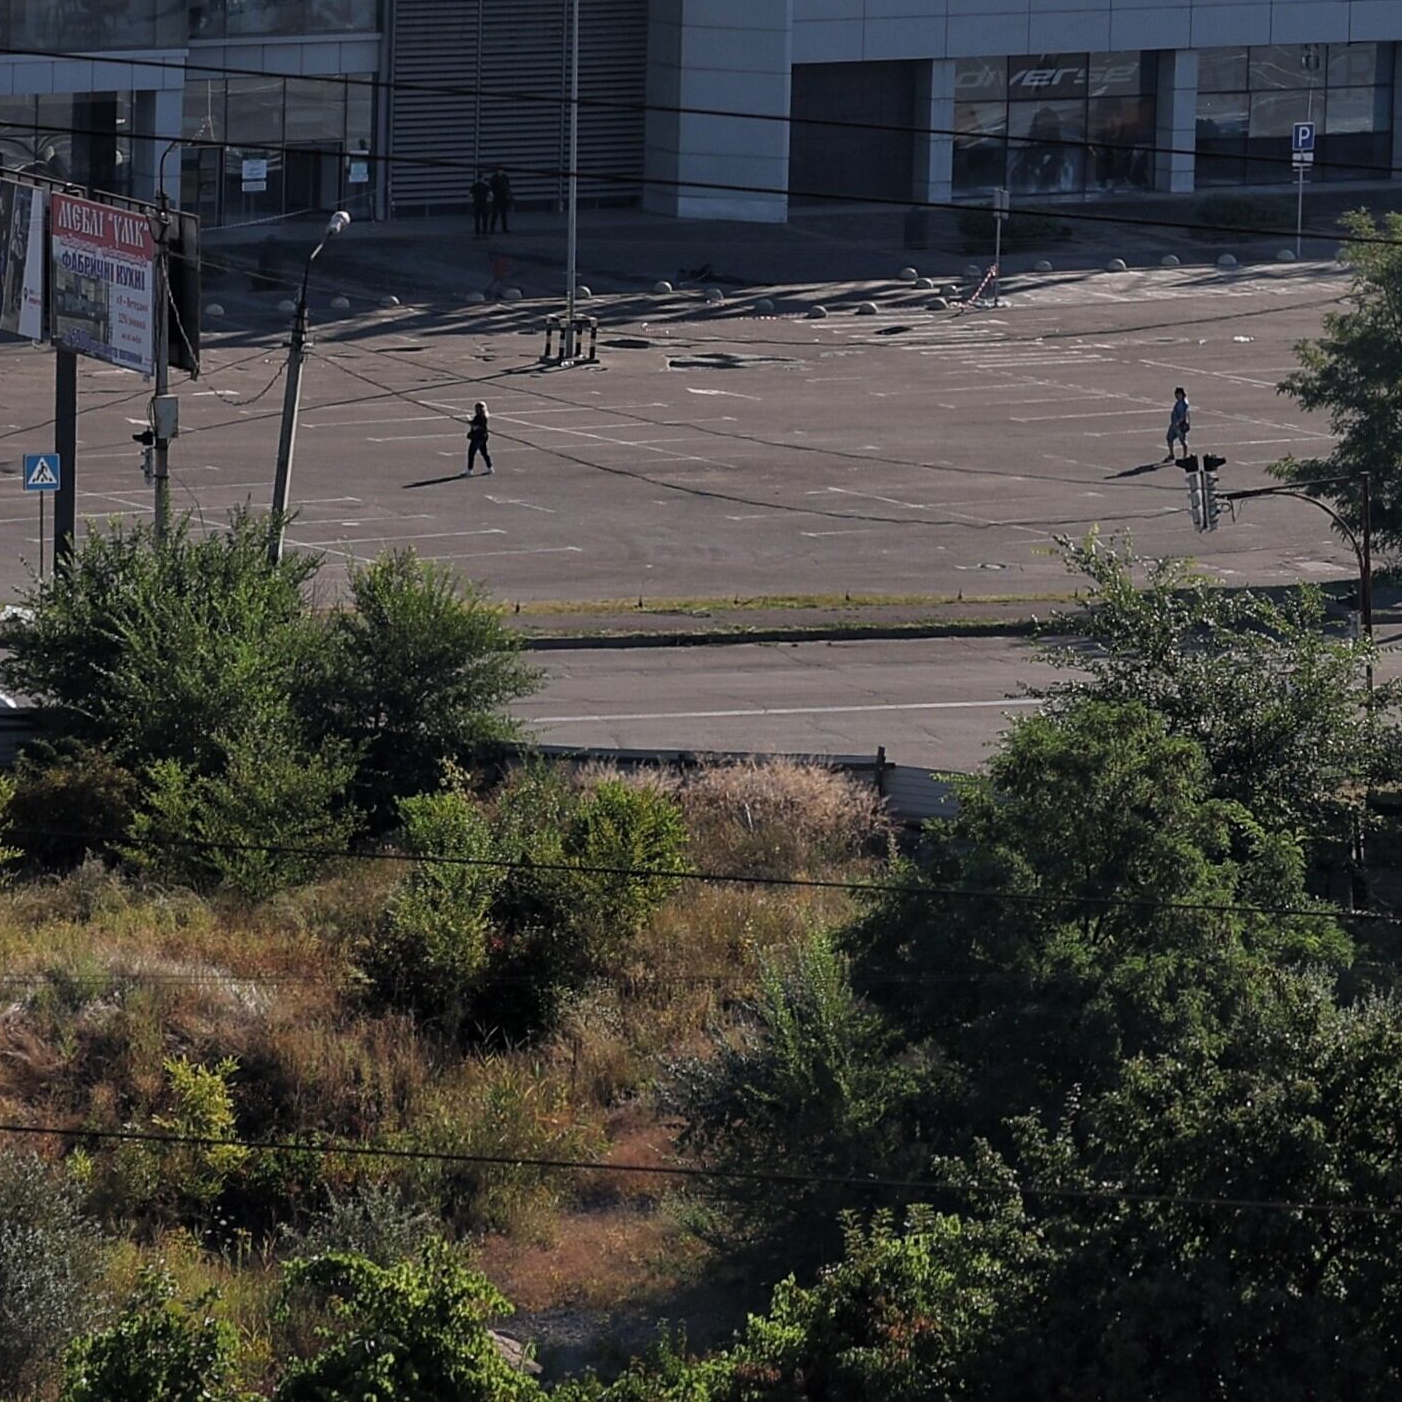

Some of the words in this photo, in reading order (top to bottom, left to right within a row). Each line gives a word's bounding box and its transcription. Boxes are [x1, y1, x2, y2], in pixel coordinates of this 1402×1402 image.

[955, 65, 1139, 89] diverse
[1298, 126, 1310, 147] P
[61, 249, 114, 282] ФАБРИЧНІ
[116, 265, 145, 291] КУХНІ
